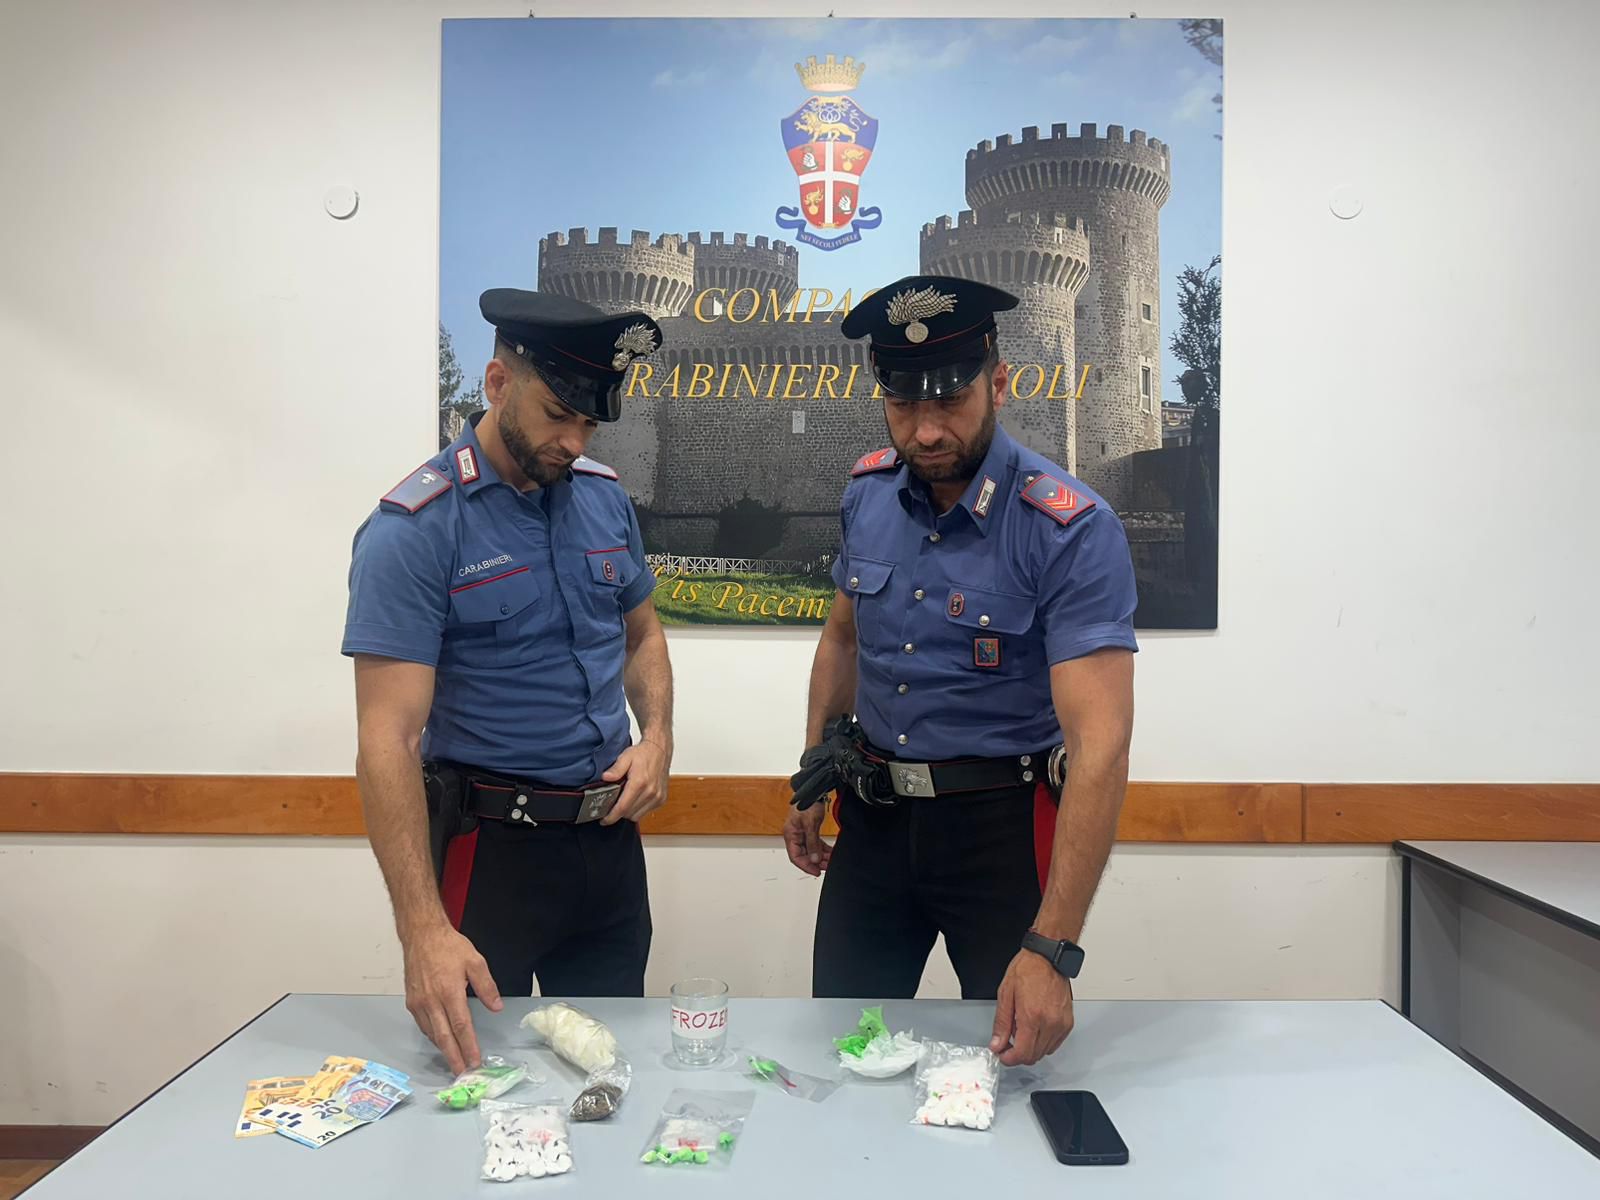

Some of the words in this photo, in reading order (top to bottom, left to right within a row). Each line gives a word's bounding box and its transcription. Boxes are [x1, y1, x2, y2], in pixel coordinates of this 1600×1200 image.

[693, 287, 882, 324] COMPA
[624, 362, 861, 400] RABINIERI
[1007, 364, 1093, 400] OLI
[458, 554, 513, 577] CARABINIERI
[711, 581, 826, 619] Pacem
[672, 1007, 728, 1029] FROZE
[312, 1106, 343, 1119] 20
[317, 1131, 336, 1141] 20
